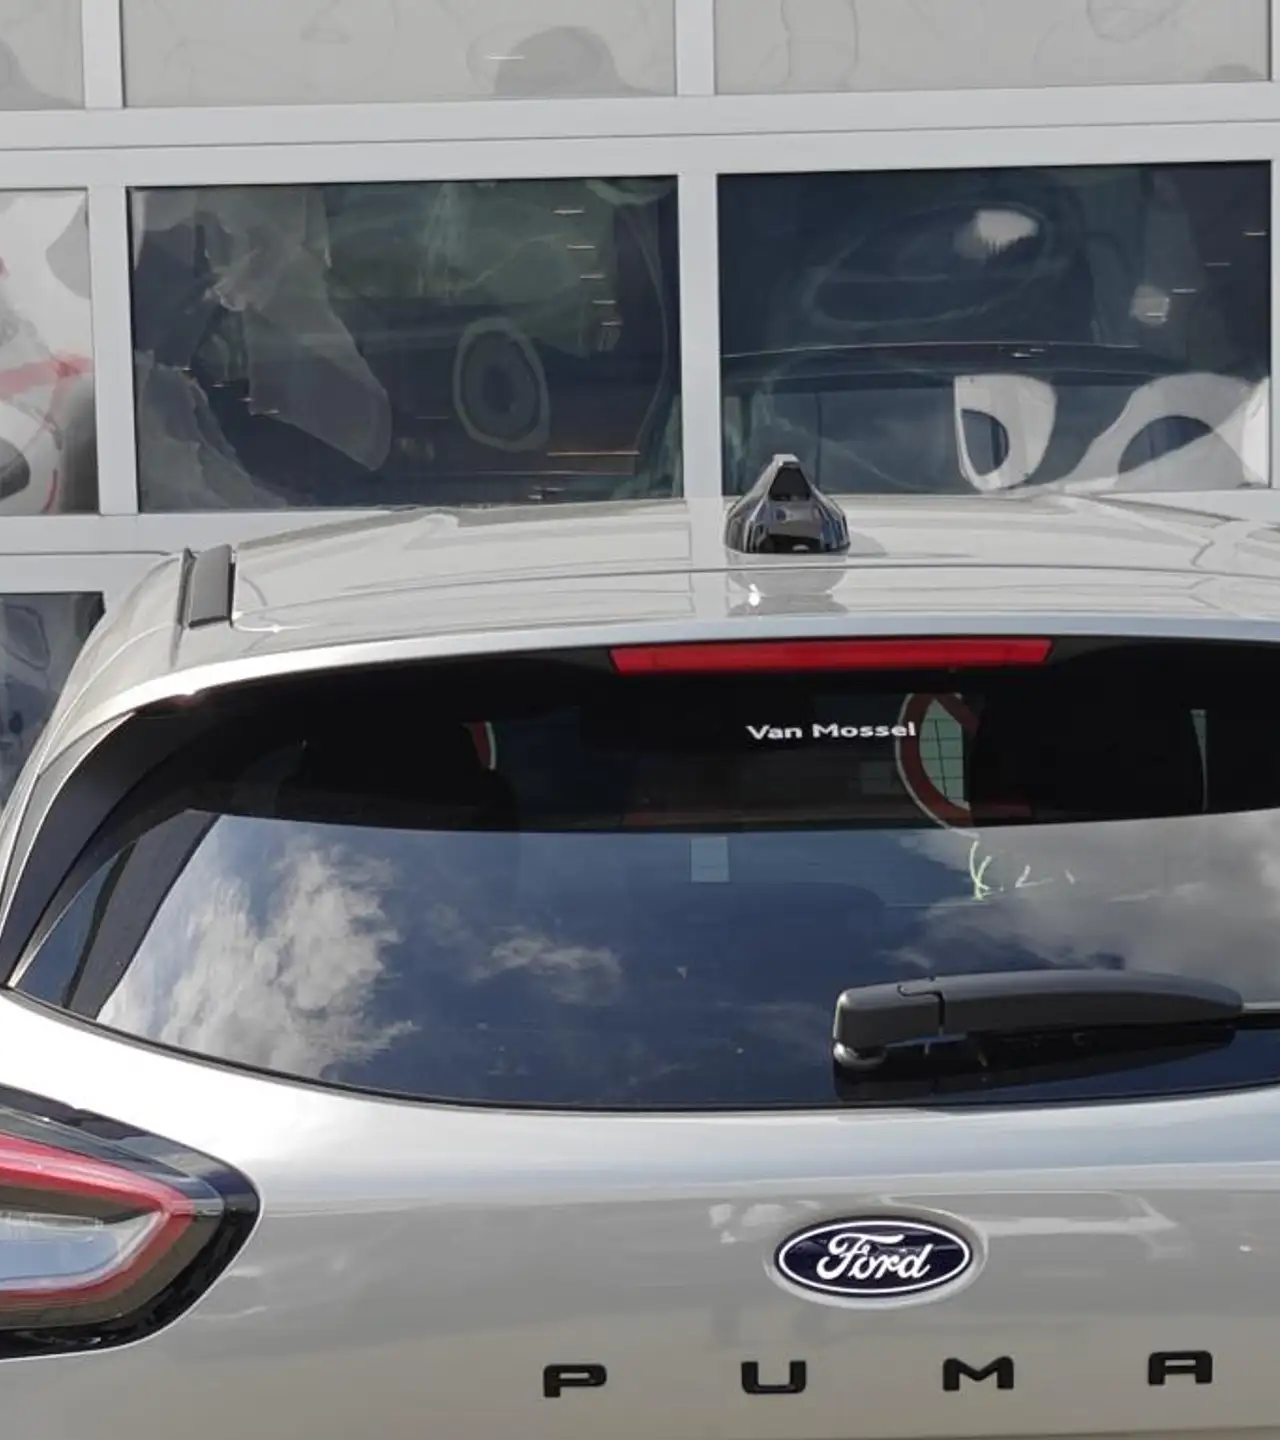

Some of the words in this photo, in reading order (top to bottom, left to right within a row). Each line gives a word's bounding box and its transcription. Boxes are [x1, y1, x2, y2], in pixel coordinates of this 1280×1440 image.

[745, 724, 803, 740] Van
[812, 721, 916, 738] Mossel
[816, 1232, 931, 1280] Ford
[543, 1350, 1213, 1398] PUMA
